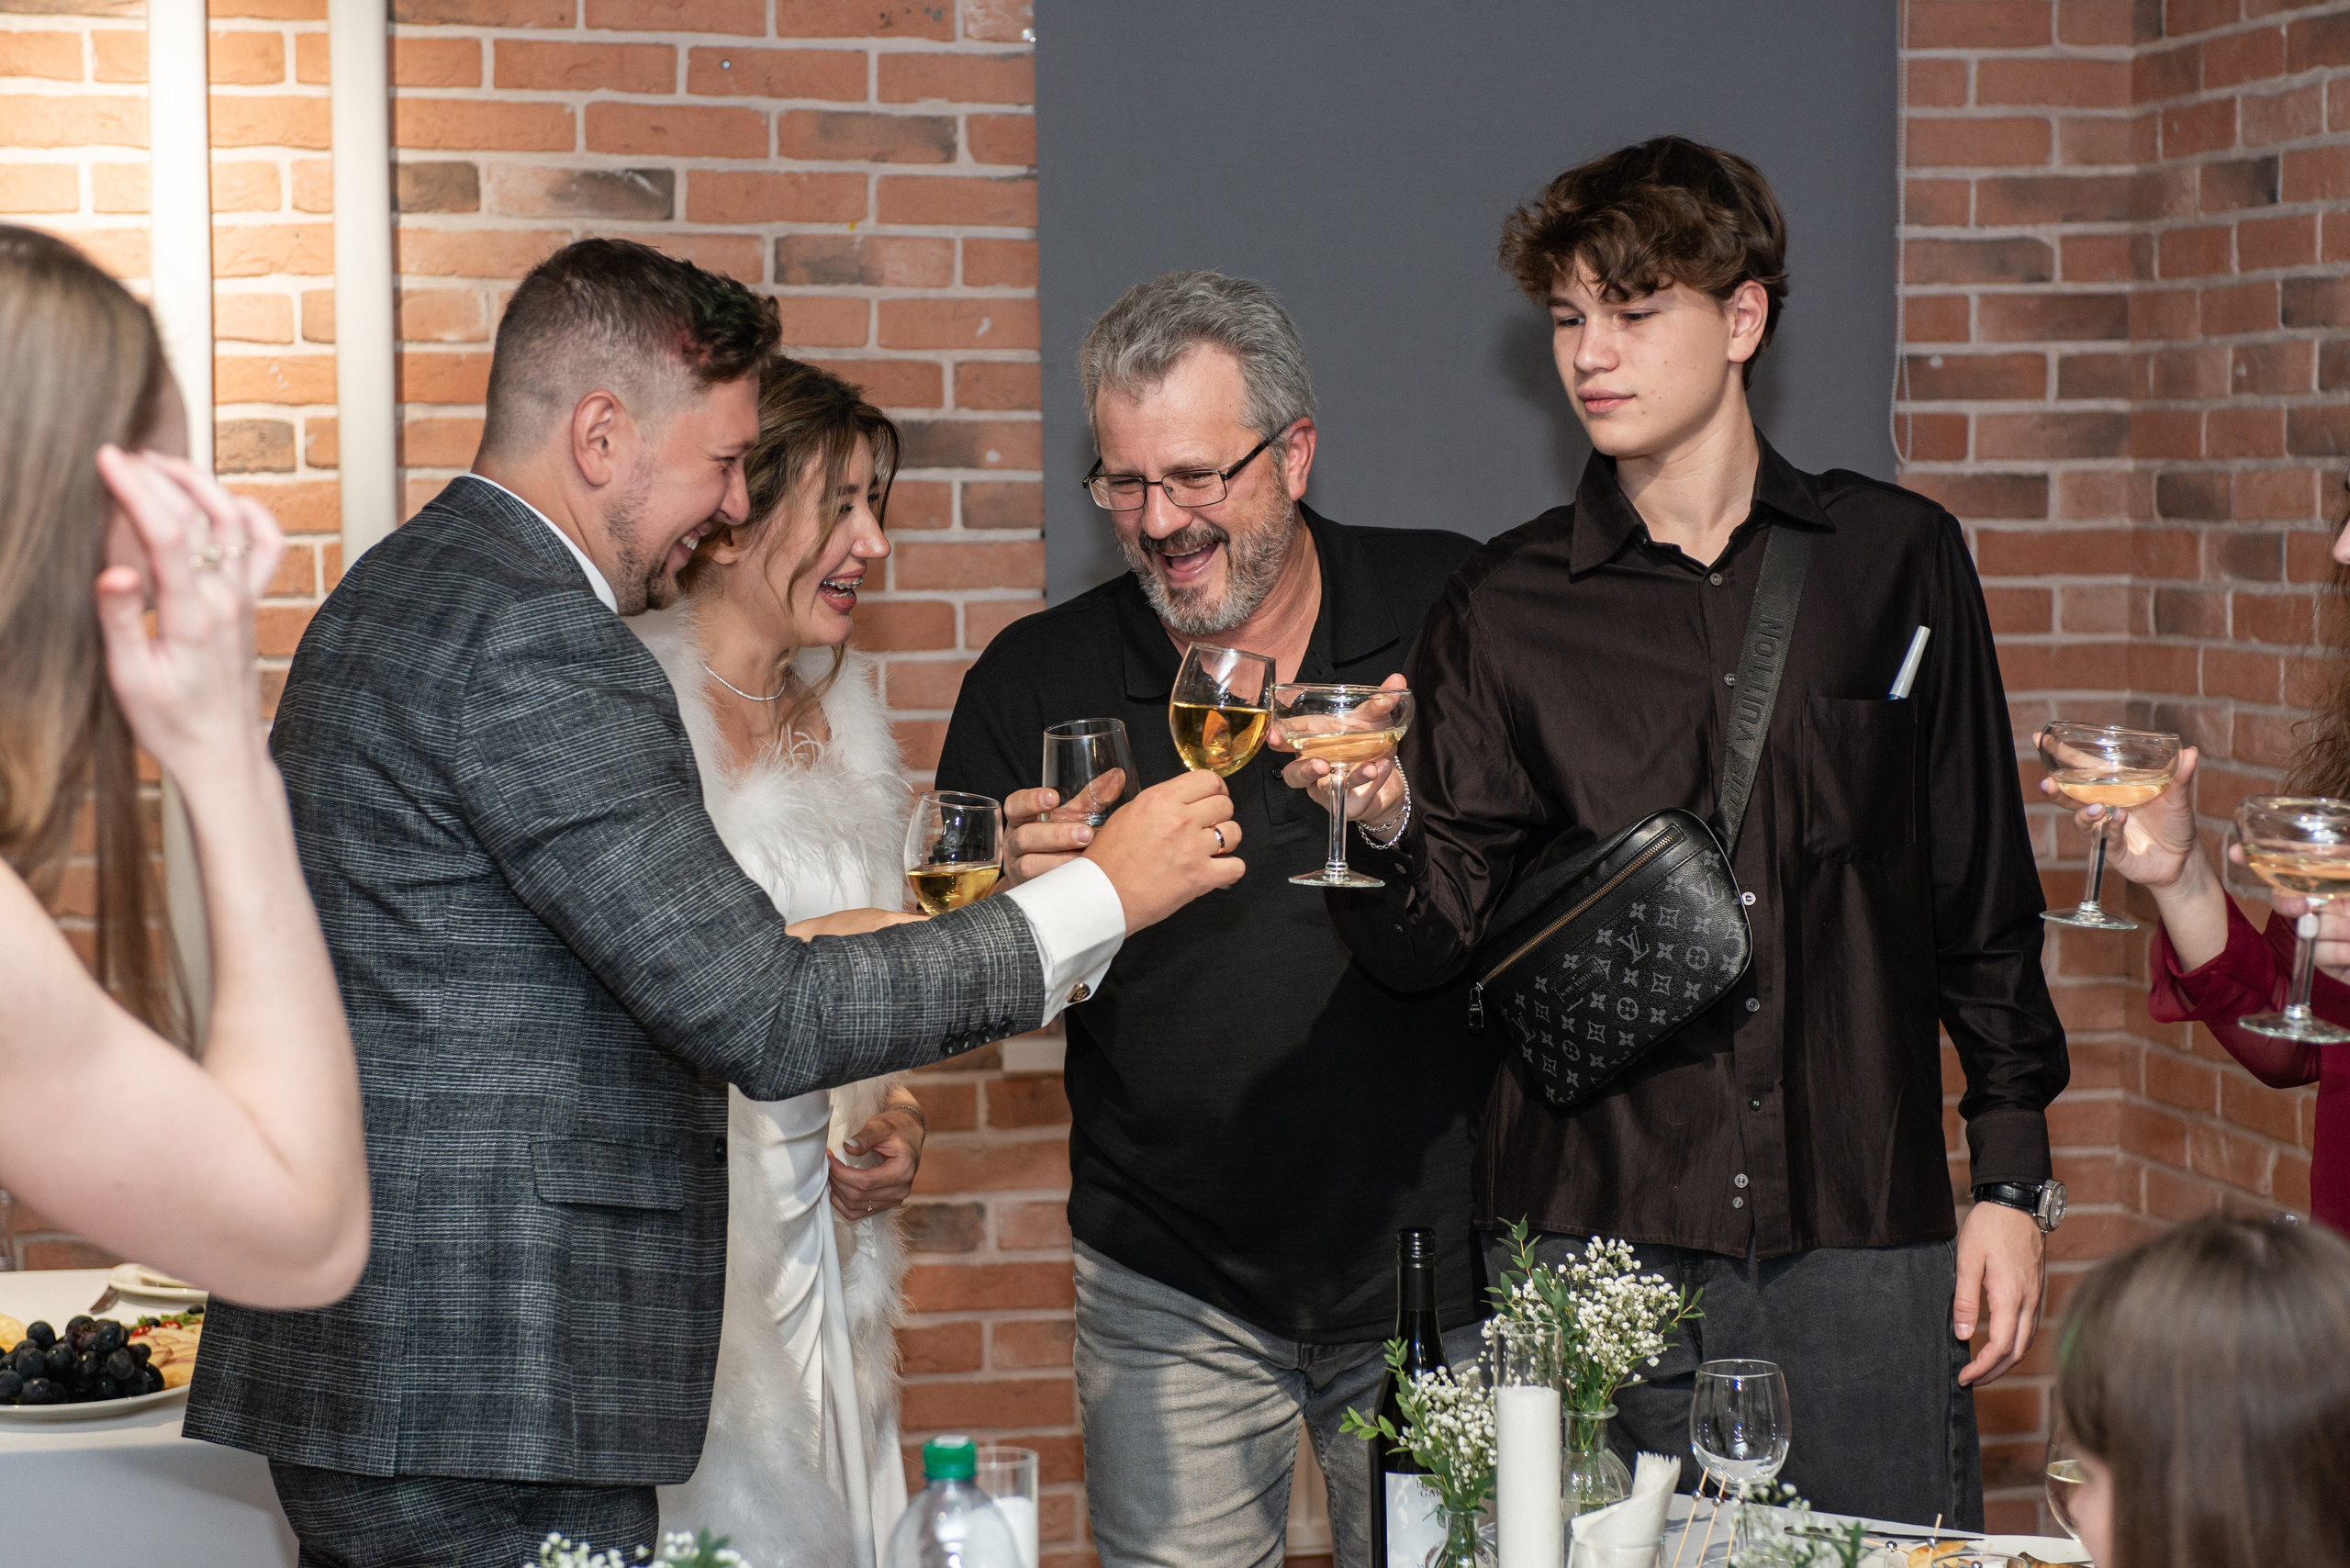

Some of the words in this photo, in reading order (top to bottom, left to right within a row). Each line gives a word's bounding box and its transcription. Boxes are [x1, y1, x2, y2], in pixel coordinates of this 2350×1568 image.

[1736, 613, 1784, 741] VUITTON
[1617, 924, 1650, 964] LV
[1420, 1489, 1442, 1497] GAR
